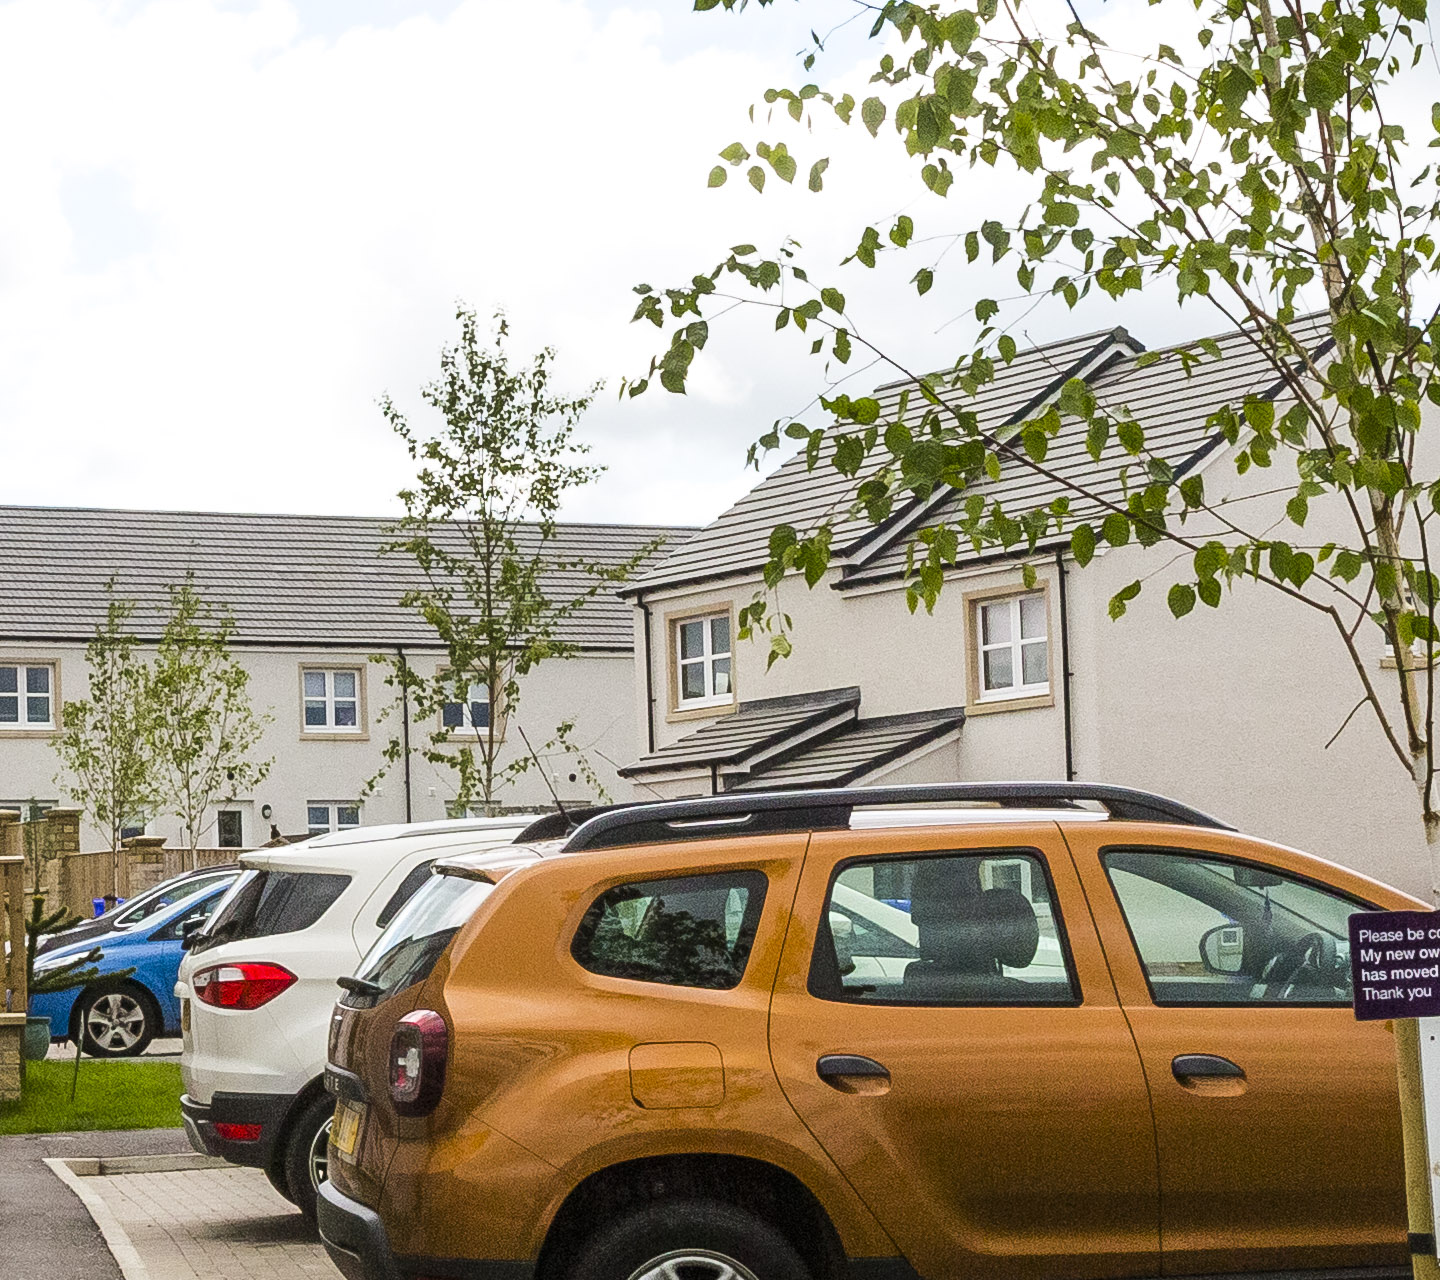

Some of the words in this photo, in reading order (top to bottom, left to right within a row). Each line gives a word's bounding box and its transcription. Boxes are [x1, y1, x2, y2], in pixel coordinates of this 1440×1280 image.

[1359, 929, 1404, 943] Please
[1407, 927, 1425, 941] be
[1360, 948, 1382, 965] My
[1385, 949, 1416, 961] new
[1361, 968, 1388, 982] has
[1390, 964, 1439, 980] moved
[1362, 986, 1405, 1001] Thank
[1407, 986, 1433, 1002] you
